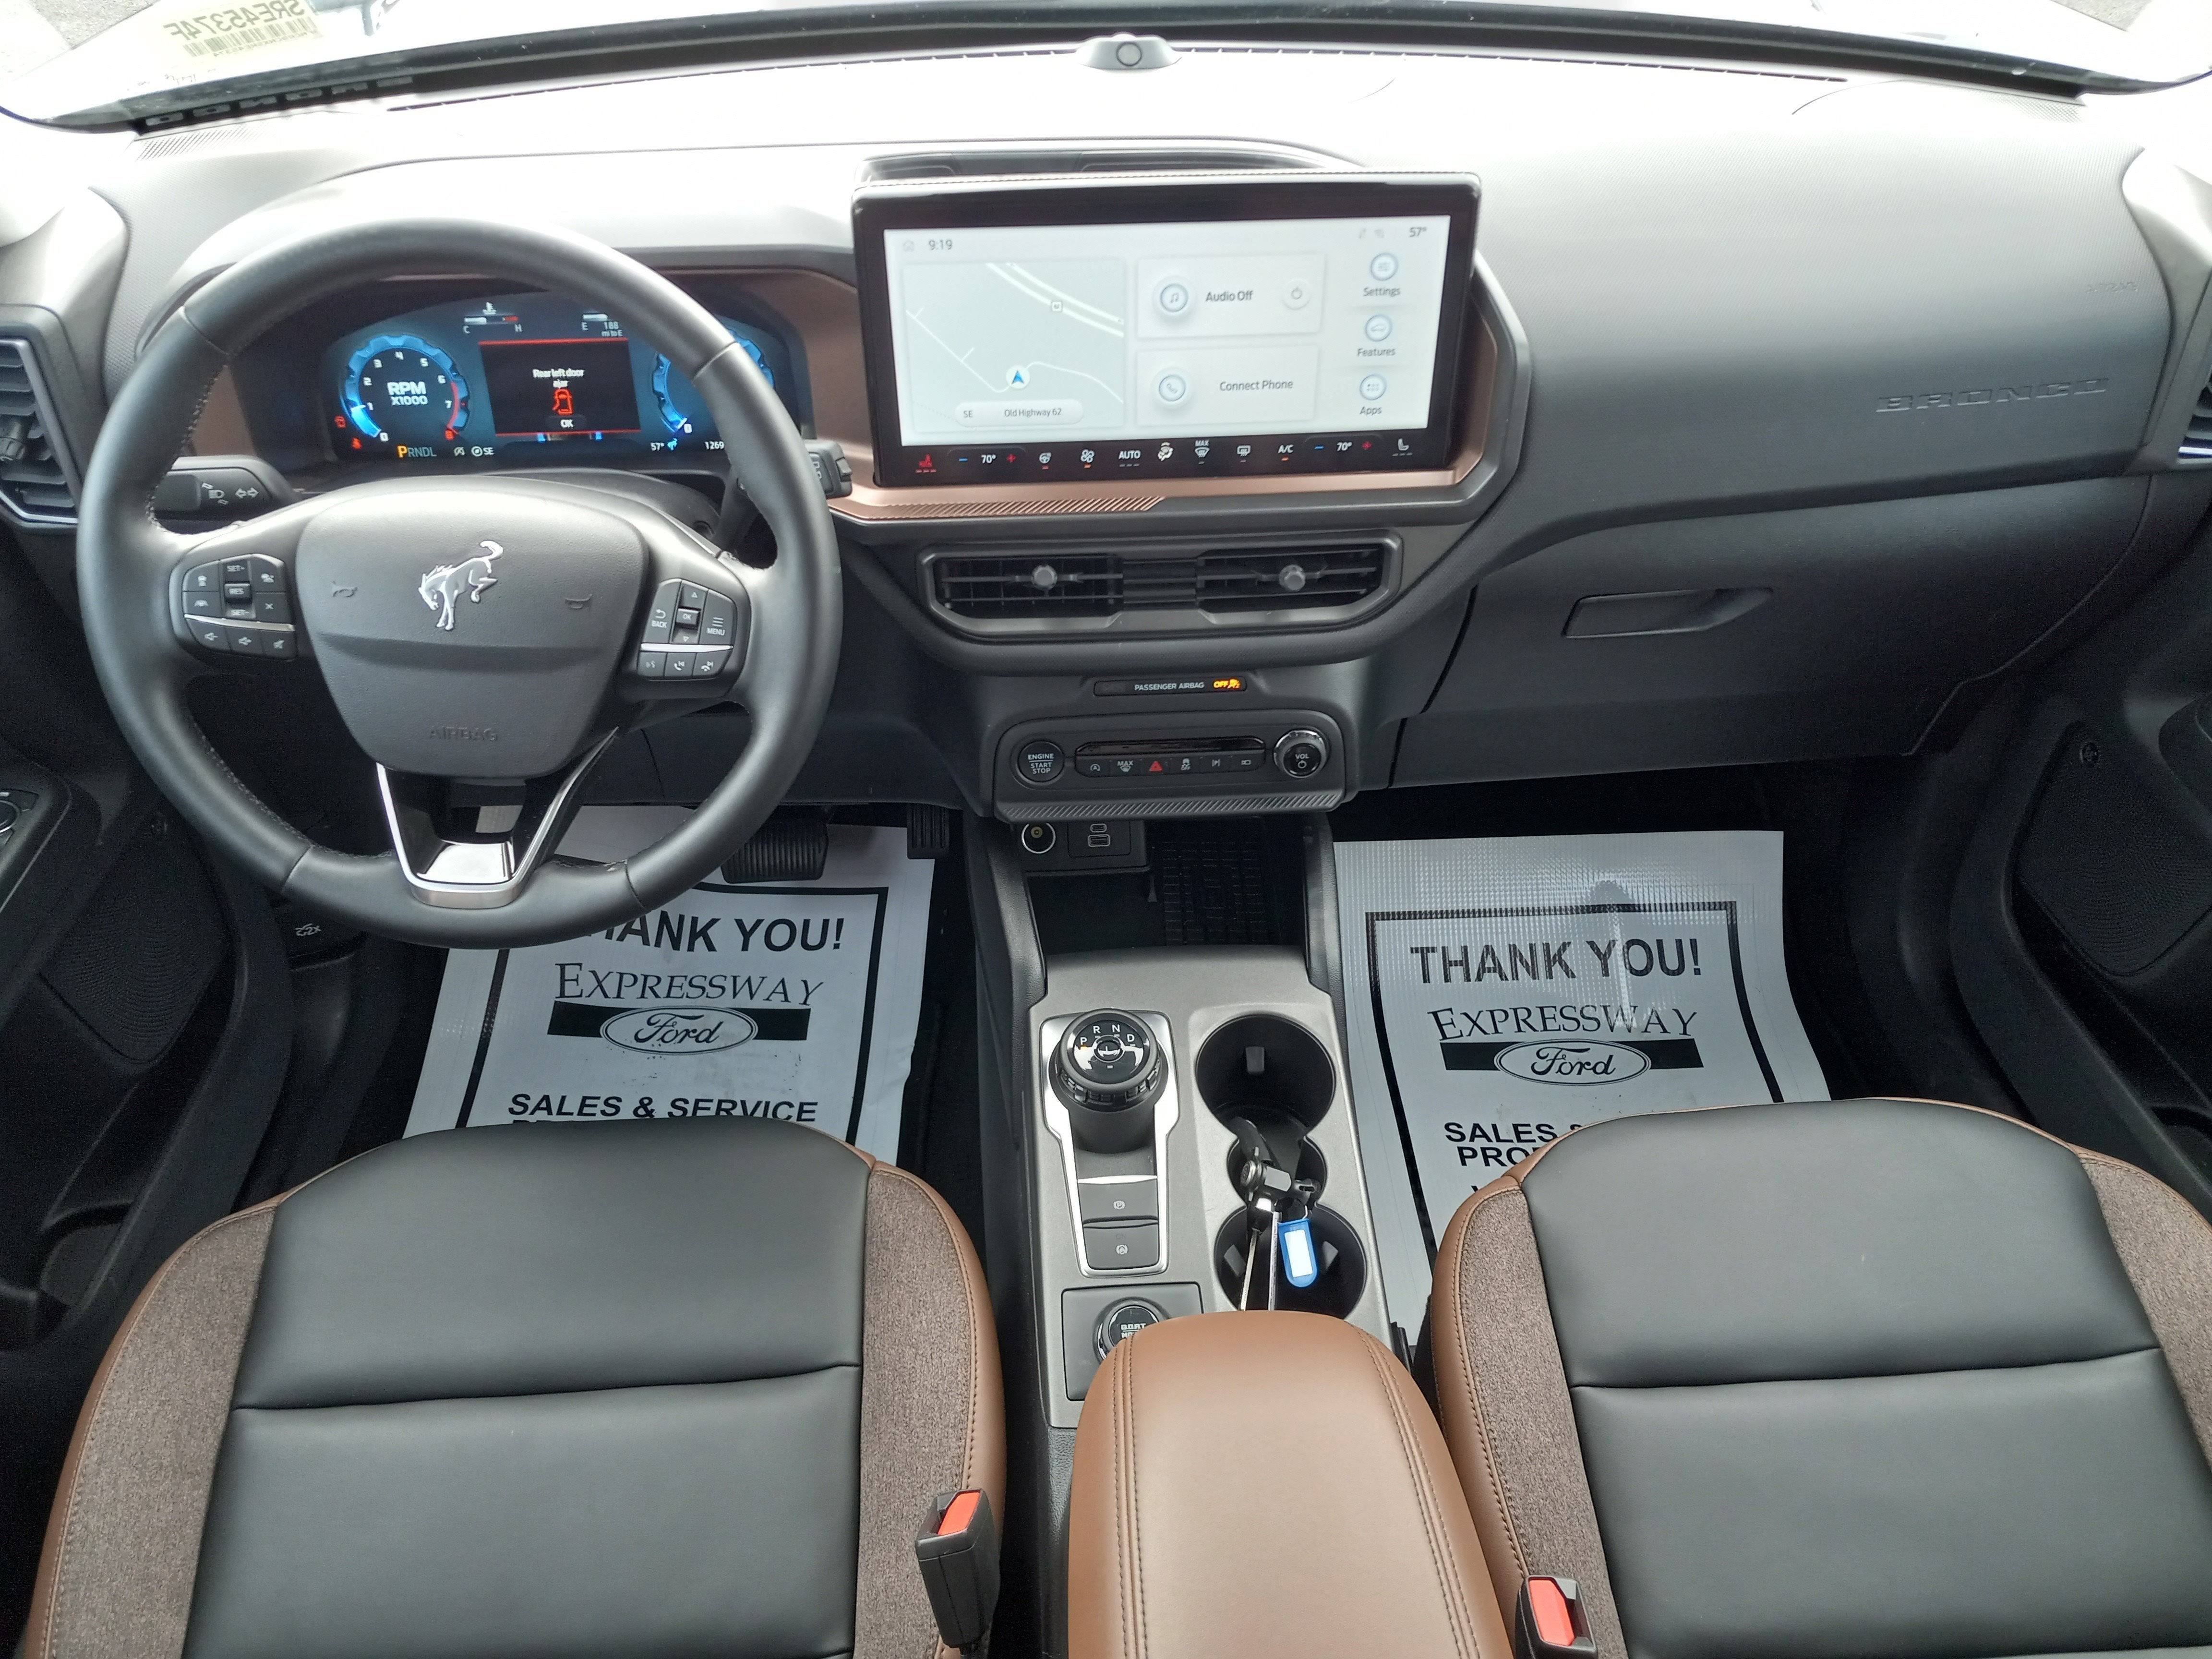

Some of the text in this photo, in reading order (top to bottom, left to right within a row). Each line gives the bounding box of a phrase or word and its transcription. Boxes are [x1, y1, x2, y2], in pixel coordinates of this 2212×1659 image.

[1409, 226, 1427, 237] 57°
[928, 240, 953, 250] 9:19
[1205, 290, 1253, 302] Audio Off
[1363, 286, 1401, 298] Settings
[463, 325, 470, 334] C
[515, 324, 522, 332] H
[581, 322, 588, 330] E
[395, 351, 404, 360] 4
[1357, 347, 1395, 357] Features
[373, 359, 382, 368] 3
[420, 358, 429, 367] 5
[363, 377, 372, 386] 2
[437, 375, 446, 384] 6
[387, 381, 427, 395] RPM
[1220, 379, 1293, 391] Connect Phone
[1875, 378, 2109, 412] BRONCO
[367, 402, 373, 410] 1
[1359, 406, 1382, 415] Apps
[963, 410, 974, 418] SE
[1004, 407, 1062, 418] Old Highway 62
[560, 419, 574, 428] OK
[1278, 444, 1294, 454] A/C
[1337, 442, 1352, 451] 70°
[981, 454, 996, 464] 70°
[1118, 450, 1141, 459] AUTO
[651, 620, 667, 628] BACK
[706, 628, 725, 636] MENU
[1134, 683, 1177, 691] PASSENGER
[1214, 680, 1229, 688] OFF
[587, 910, 845, 952] ANK YOU!
[1410, 938, 1702, 984] THANK YOU!
[634, 1012, 724, 1046] Ford
[1112, 1024, 1120, 1032] N
[1080, 1037, 1087, 1045] P
[1127, 1034, 1135, 1042] D
[1530, 1046, 1616, 1077] Ford
[508, 1094, 818, 1122] SALES & SERVICE
[1444, 1122, 1558, 1143] SALES
[1456, 1146, 1540, 1167] PRO
